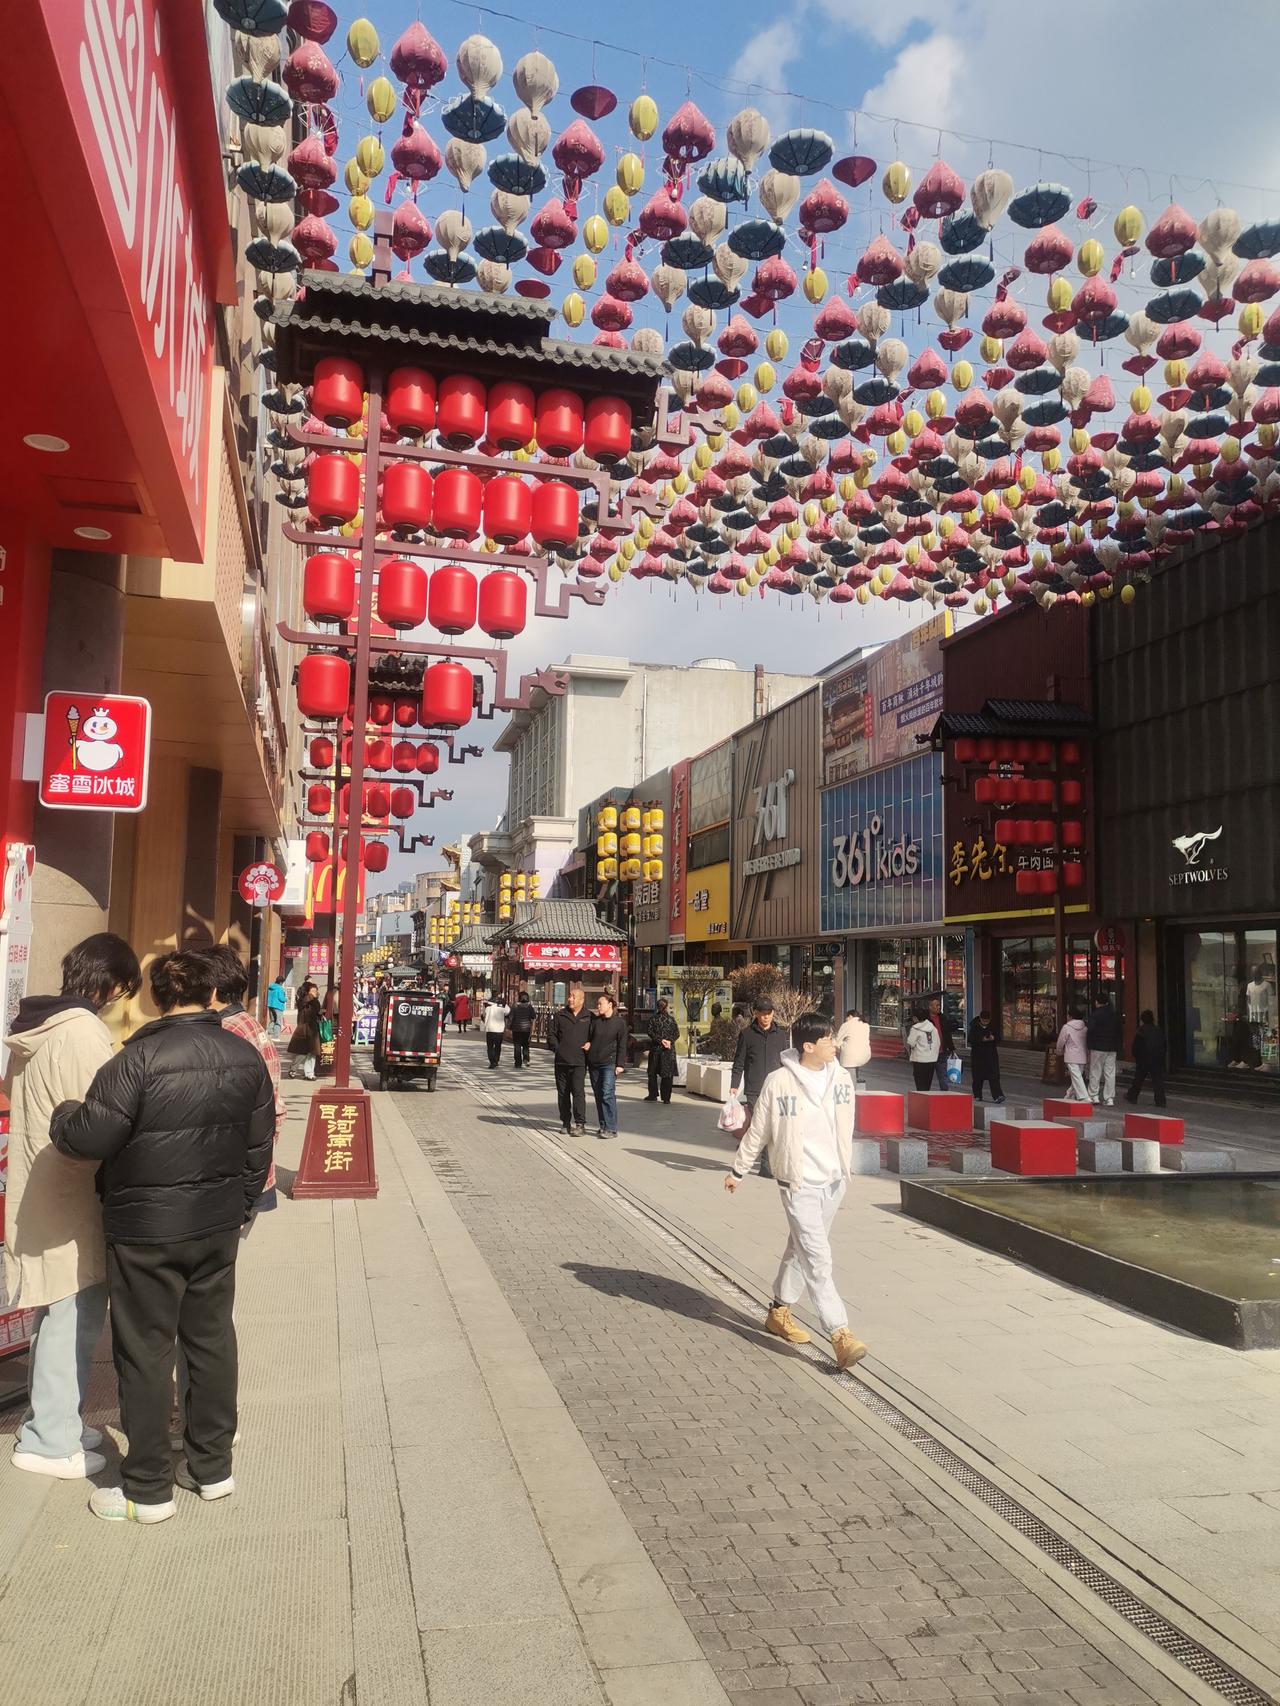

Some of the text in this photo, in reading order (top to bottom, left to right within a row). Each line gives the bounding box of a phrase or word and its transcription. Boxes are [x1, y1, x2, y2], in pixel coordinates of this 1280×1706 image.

[48, 773, 135, 797] 蜜雪冰城
[876, 832, 920, 881] kids
[1168, 867, 1229, 886] SEPTWOLVES
[324, 1119, 356, 1173] 河南街
